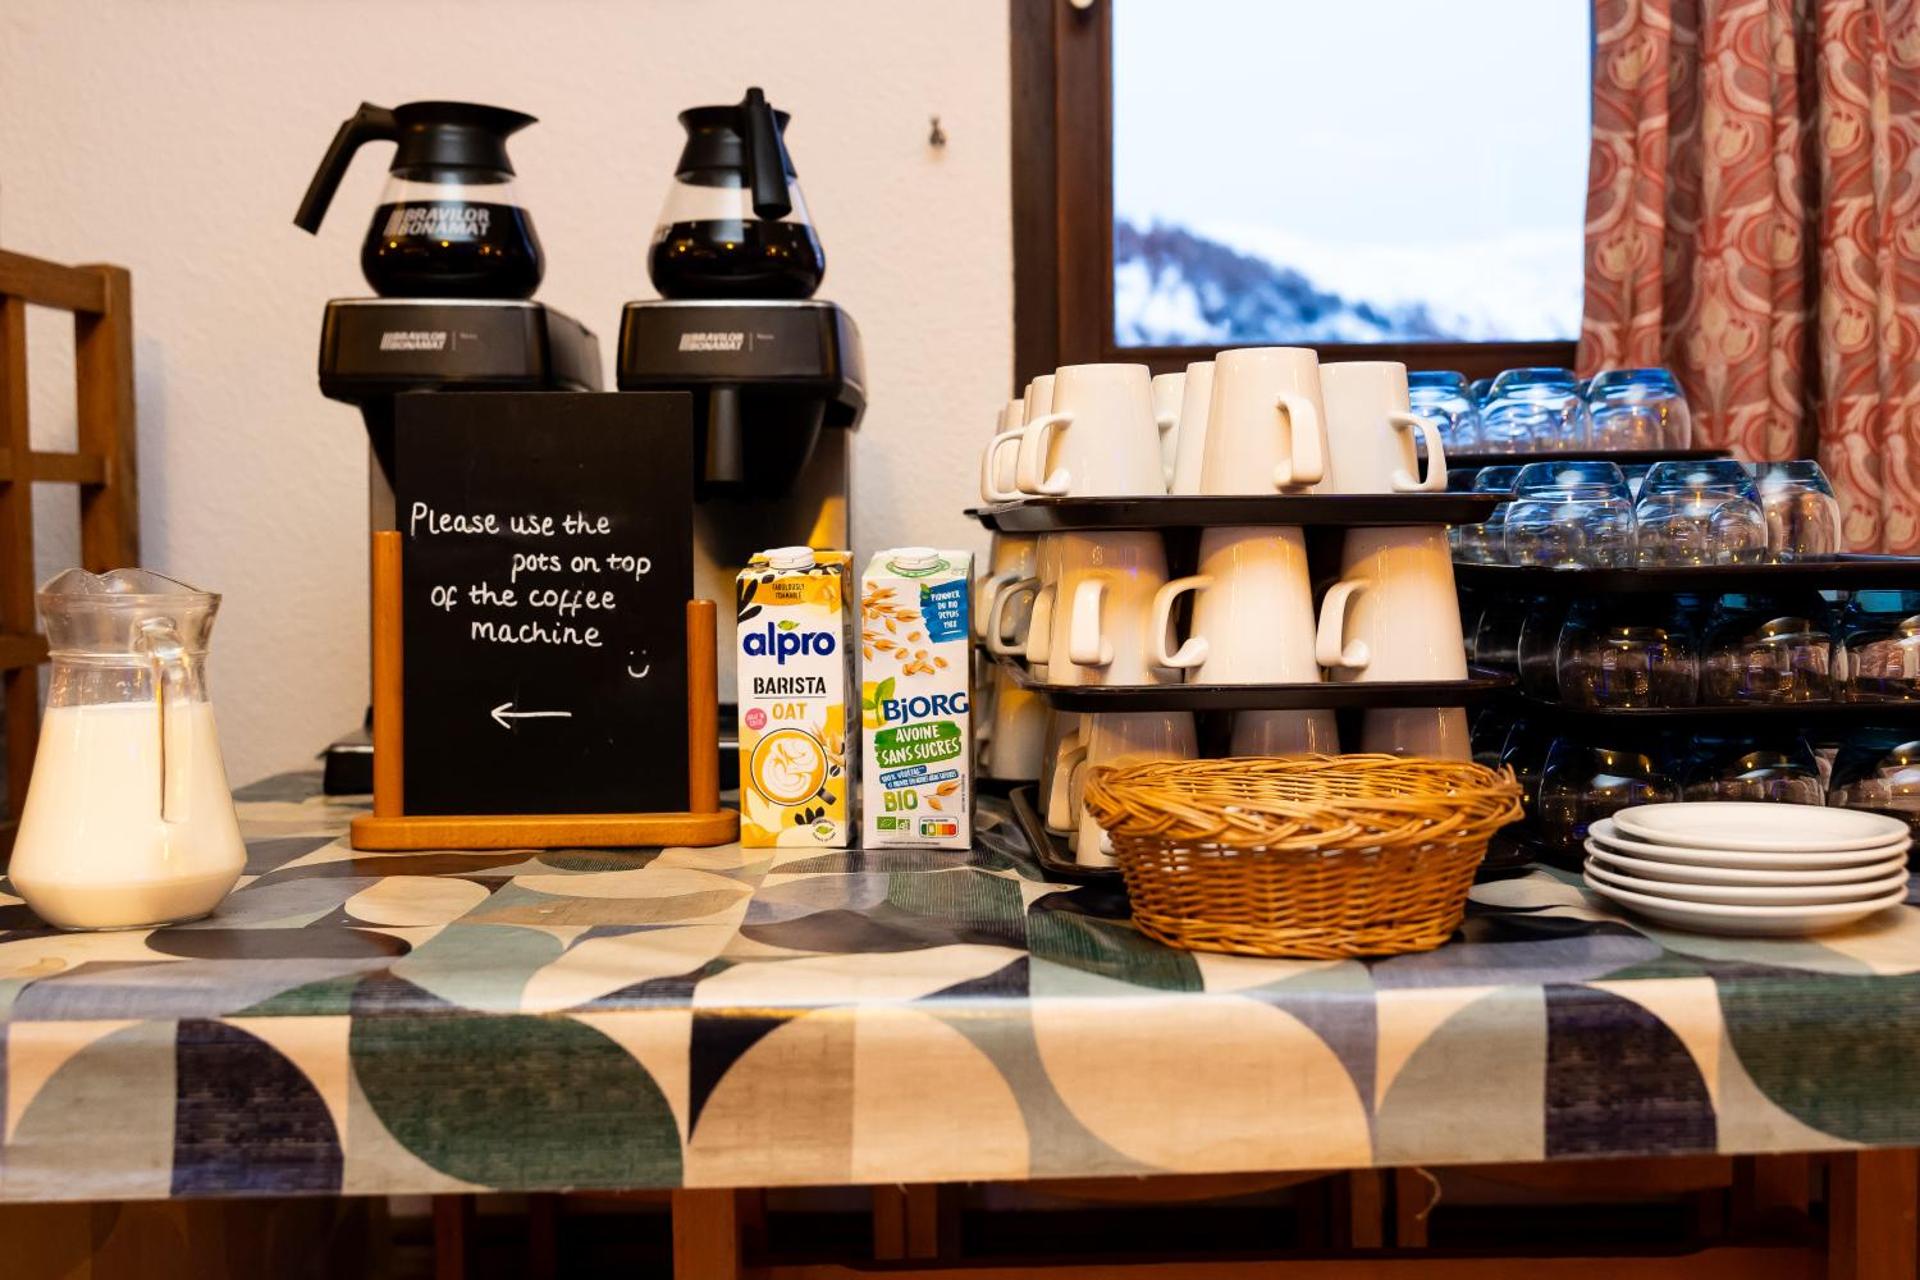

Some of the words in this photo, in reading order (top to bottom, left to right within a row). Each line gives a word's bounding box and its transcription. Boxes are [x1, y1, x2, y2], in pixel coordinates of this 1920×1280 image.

[403, 207, 490, 222] BRAVILOR
[398, 221, 489, 236] BONAMAT
[410, 502, 500, 537] Please
[510, 513, 555, 536] use
[562, 511, 611, 535] the
[511, 553, 562, 584] pots
[570, 556, 601, 573] on
[606, 553, 652, 582] top
[469, 581, 518, 607] the
[528, 588, 616, 616] coffee
[471, 621, 603, 647] machine
[742, 621, 836, 665] alpro
[753, 677, 827, 695] BARISTA
[772, 703, 807, 720] OAT
[895, 725, 940, 743] AVOINE
[881, 745, 914, 765] SANS
[914, 737, 960, 760] SUCRES
[883, 788, 918, 812] BIO
